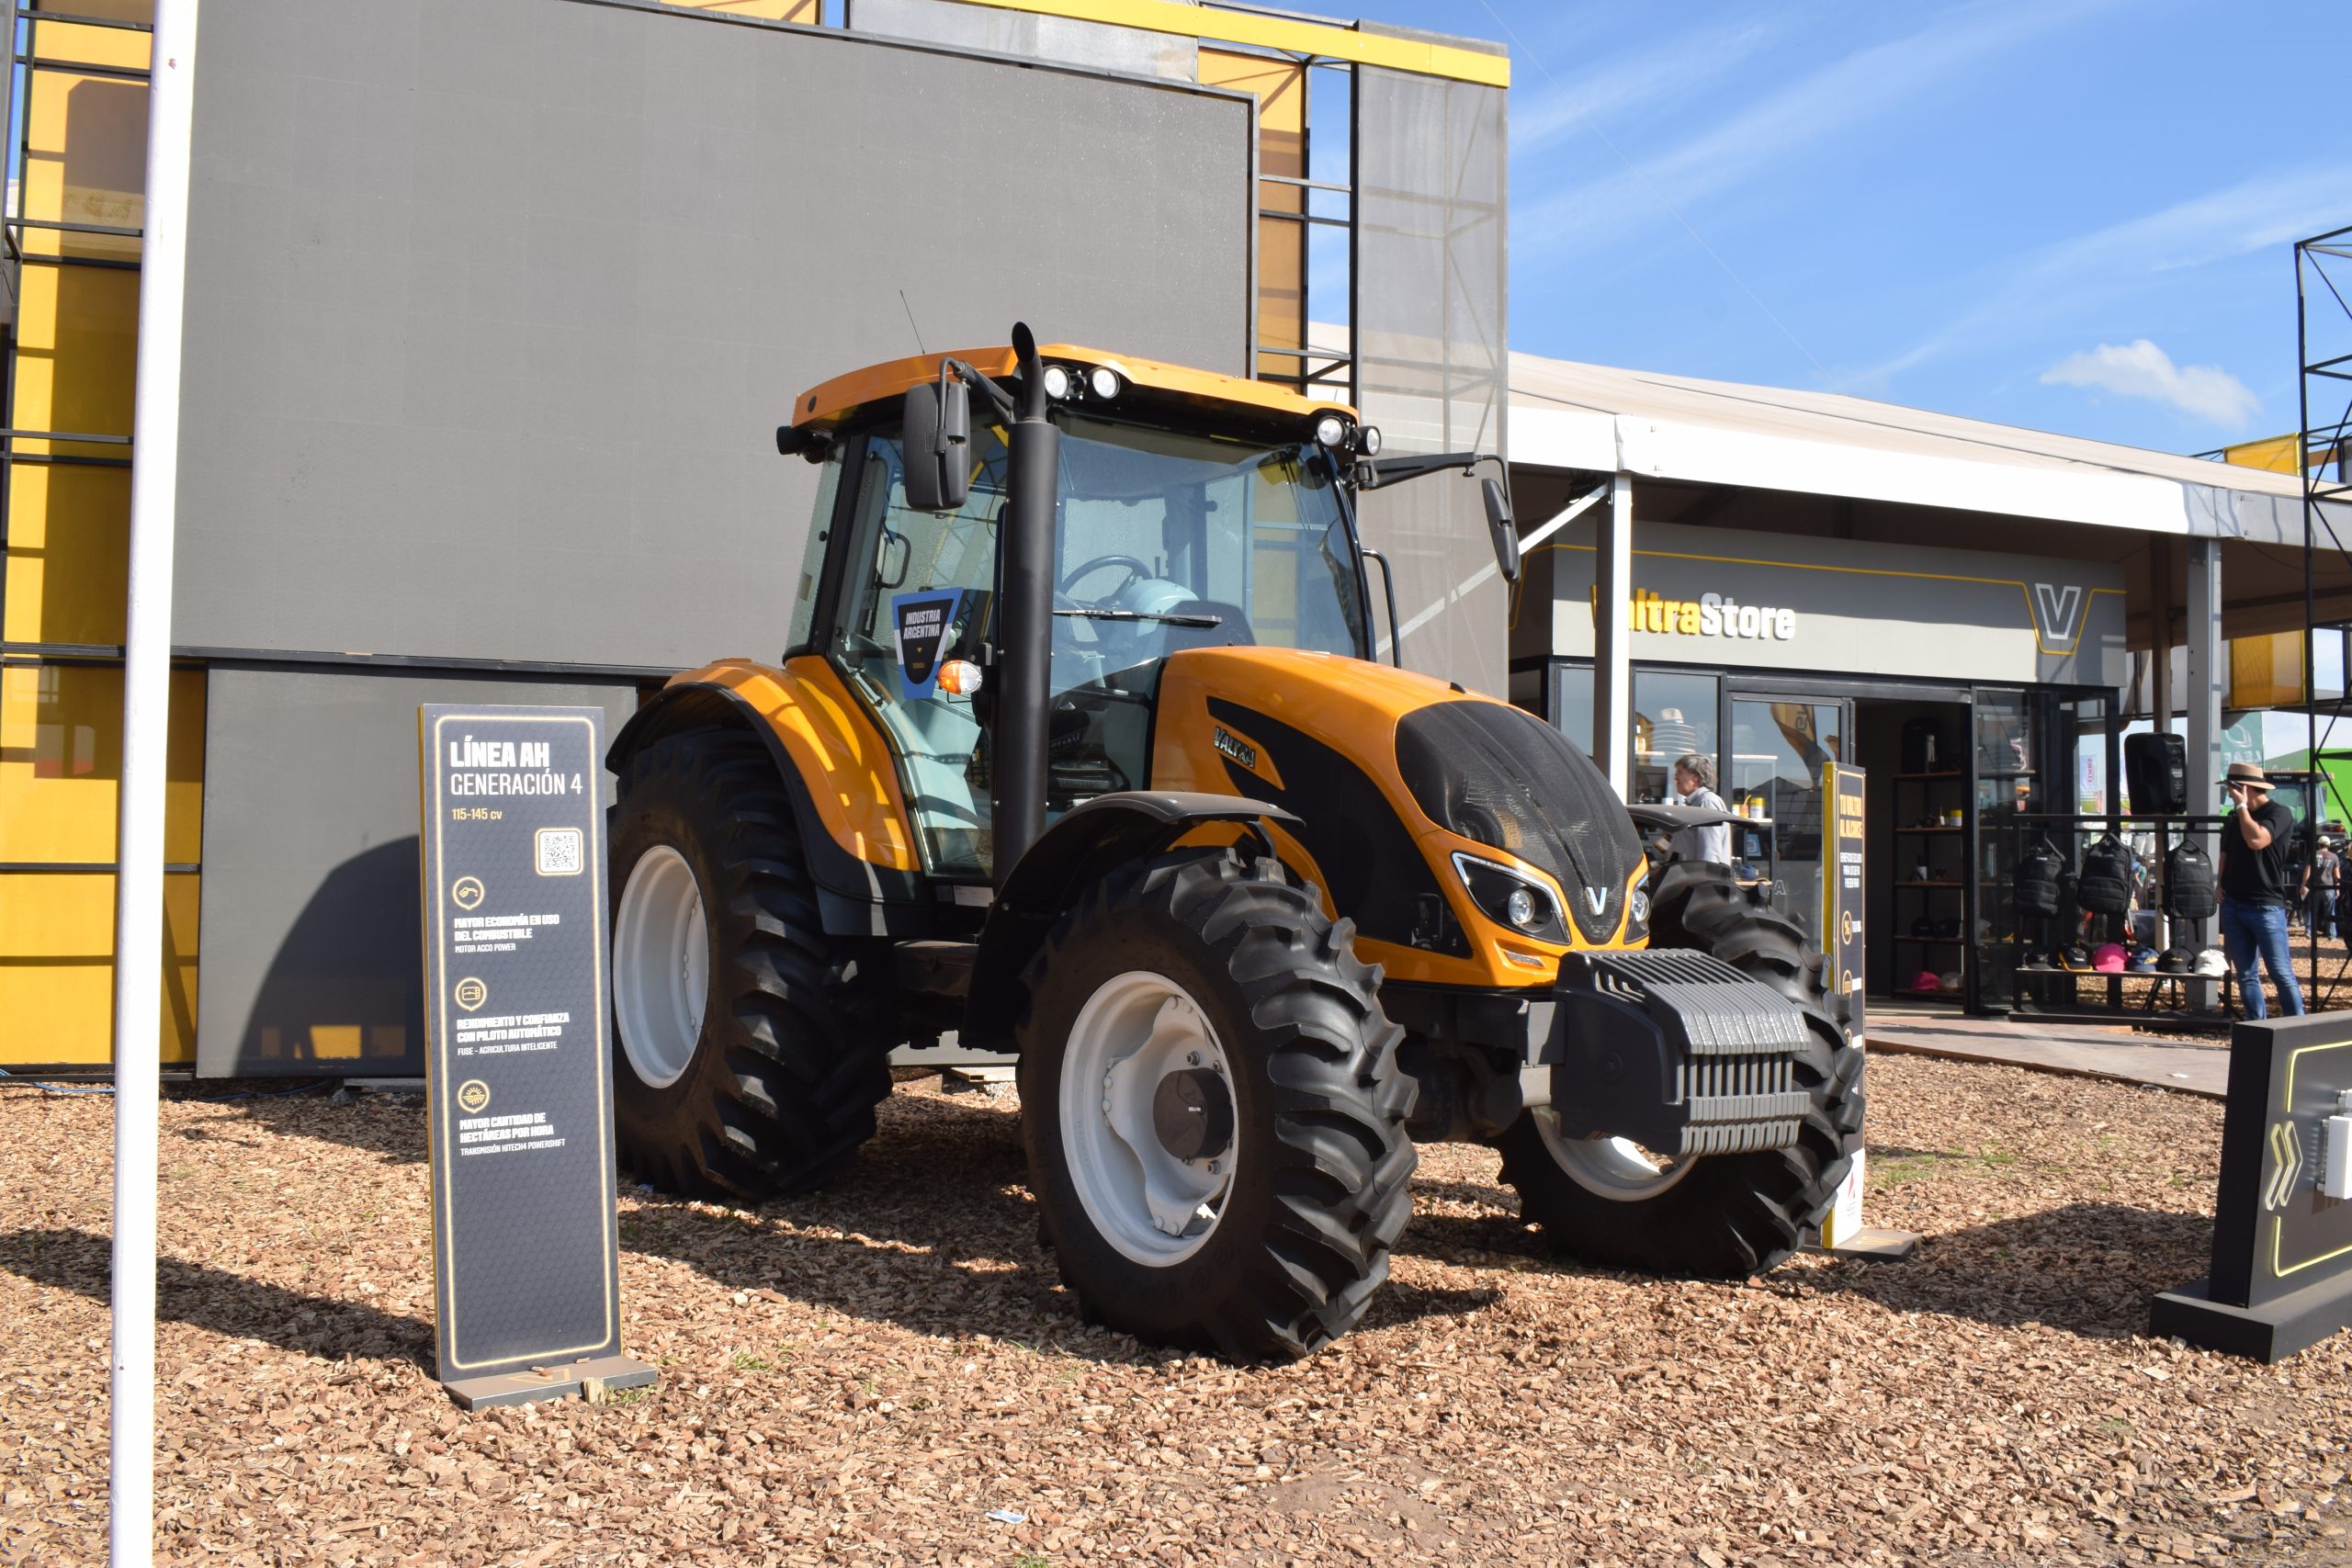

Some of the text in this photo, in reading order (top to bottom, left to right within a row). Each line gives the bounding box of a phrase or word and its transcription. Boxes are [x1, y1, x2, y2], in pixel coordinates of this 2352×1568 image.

[906, 609, 941, 626] INDUSTRIA
[903, 624, 940, 640] ARGENTINA
[450, 735, 550, 768] LÍNEA AH
[1214, 726, 1256, 768] VALTRA
[450, 768, 583, 795] GENERACIÓN 4
[452, 808, 503, 820] 115-145 cv
[454, 913, 560, 928] MAYOR ECONOMÍA EN USO
[454, 928, 533, 942] DEL COMBUSTIBLE
[493, 943, 515, 952] POWER
[457, 1012, 570, 1030] RENDIMIENTO Y CONFIANZA
[457, 1025, 562, 1043] CON PILOTO AUTOMÁTICO
[458, 1047, 473, 1056] FUSE
[479, 1044, 521, 1055] AGRICULTURA
[521, 1042, 558, 1052] INTELIGENTE
[459, 1112, 546, 1130] MAYOR CANTIDAD DE
[459, 1124, 554, 1144] HECTÁREAS POR HORA
[460, 1138, 566, 1156] TRANSMISIÓN HITECH4 POWERSHIFT
